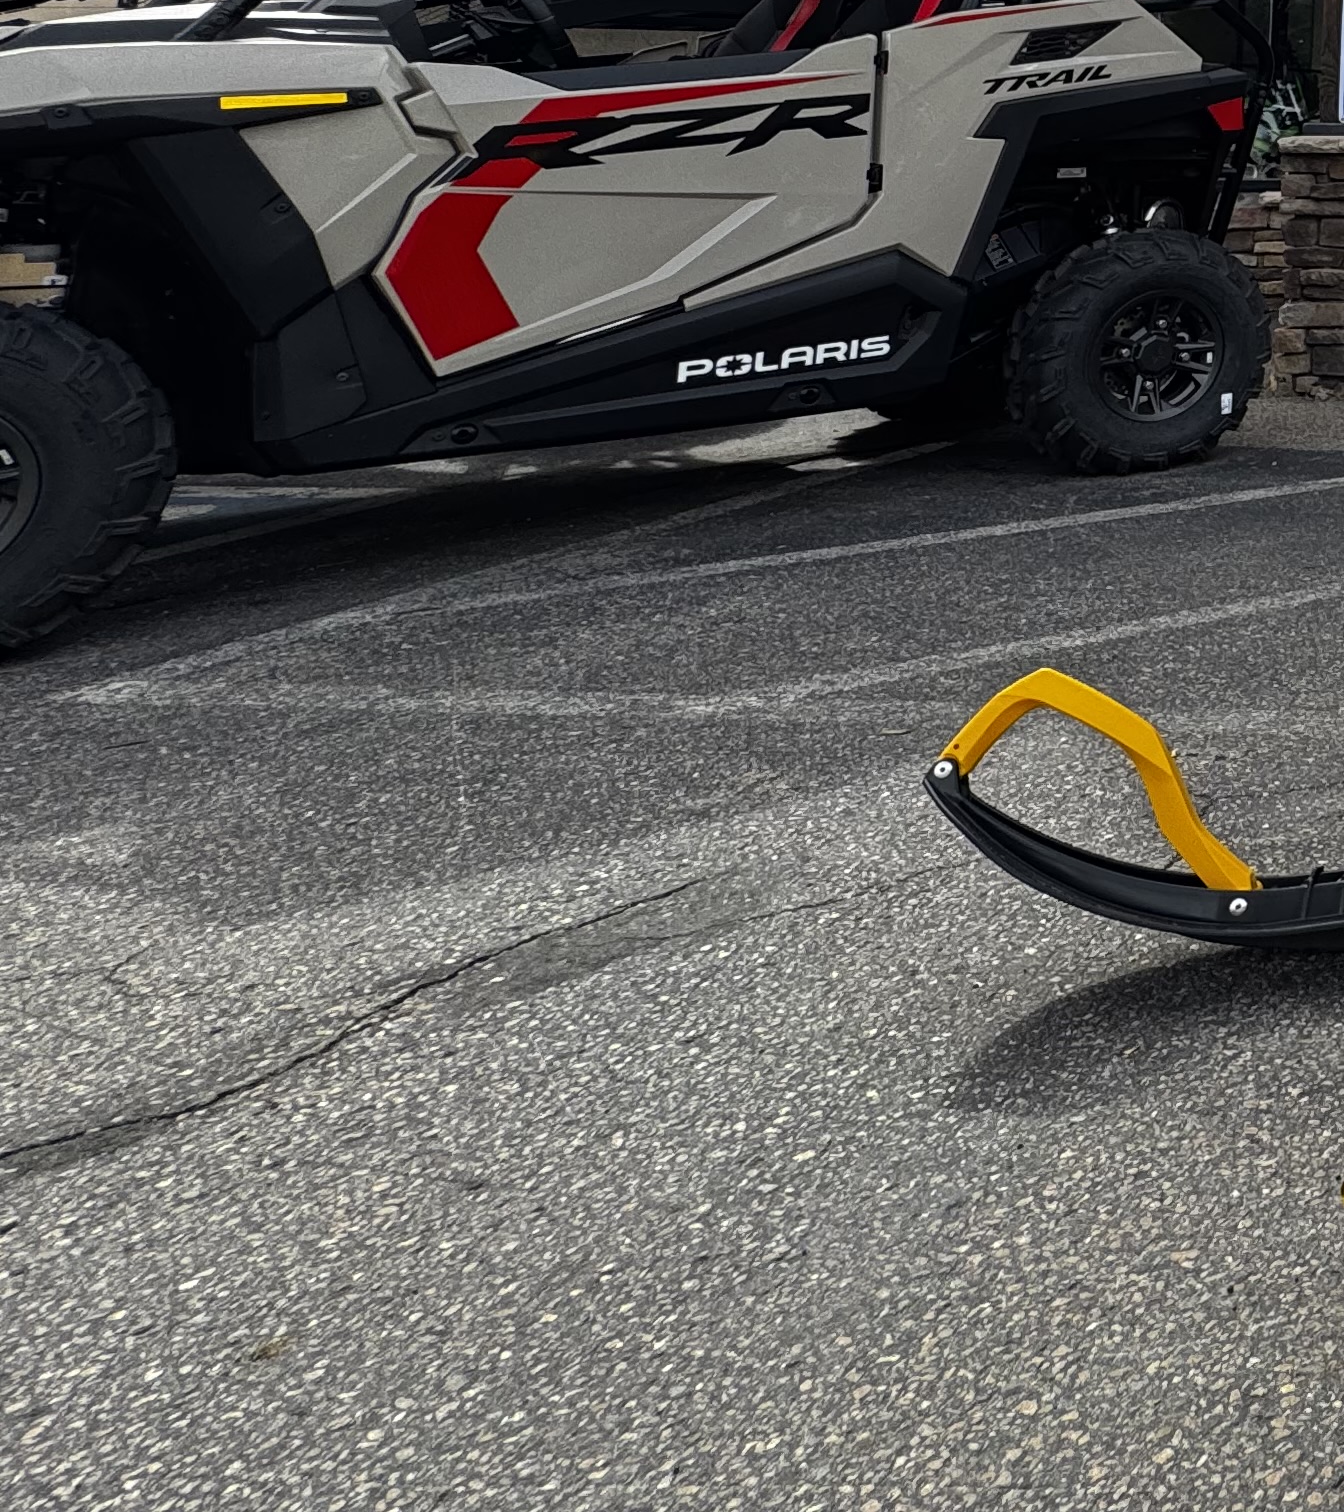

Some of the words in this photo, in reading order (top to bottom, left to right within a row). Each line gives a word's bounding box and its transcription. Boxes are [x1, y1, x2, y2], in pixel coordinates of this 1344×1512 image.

[982, 64, 1112, 95] TRAIL
[450, 93, 872, 180] RZR
[677, 335, 891, 383] POLARIS
